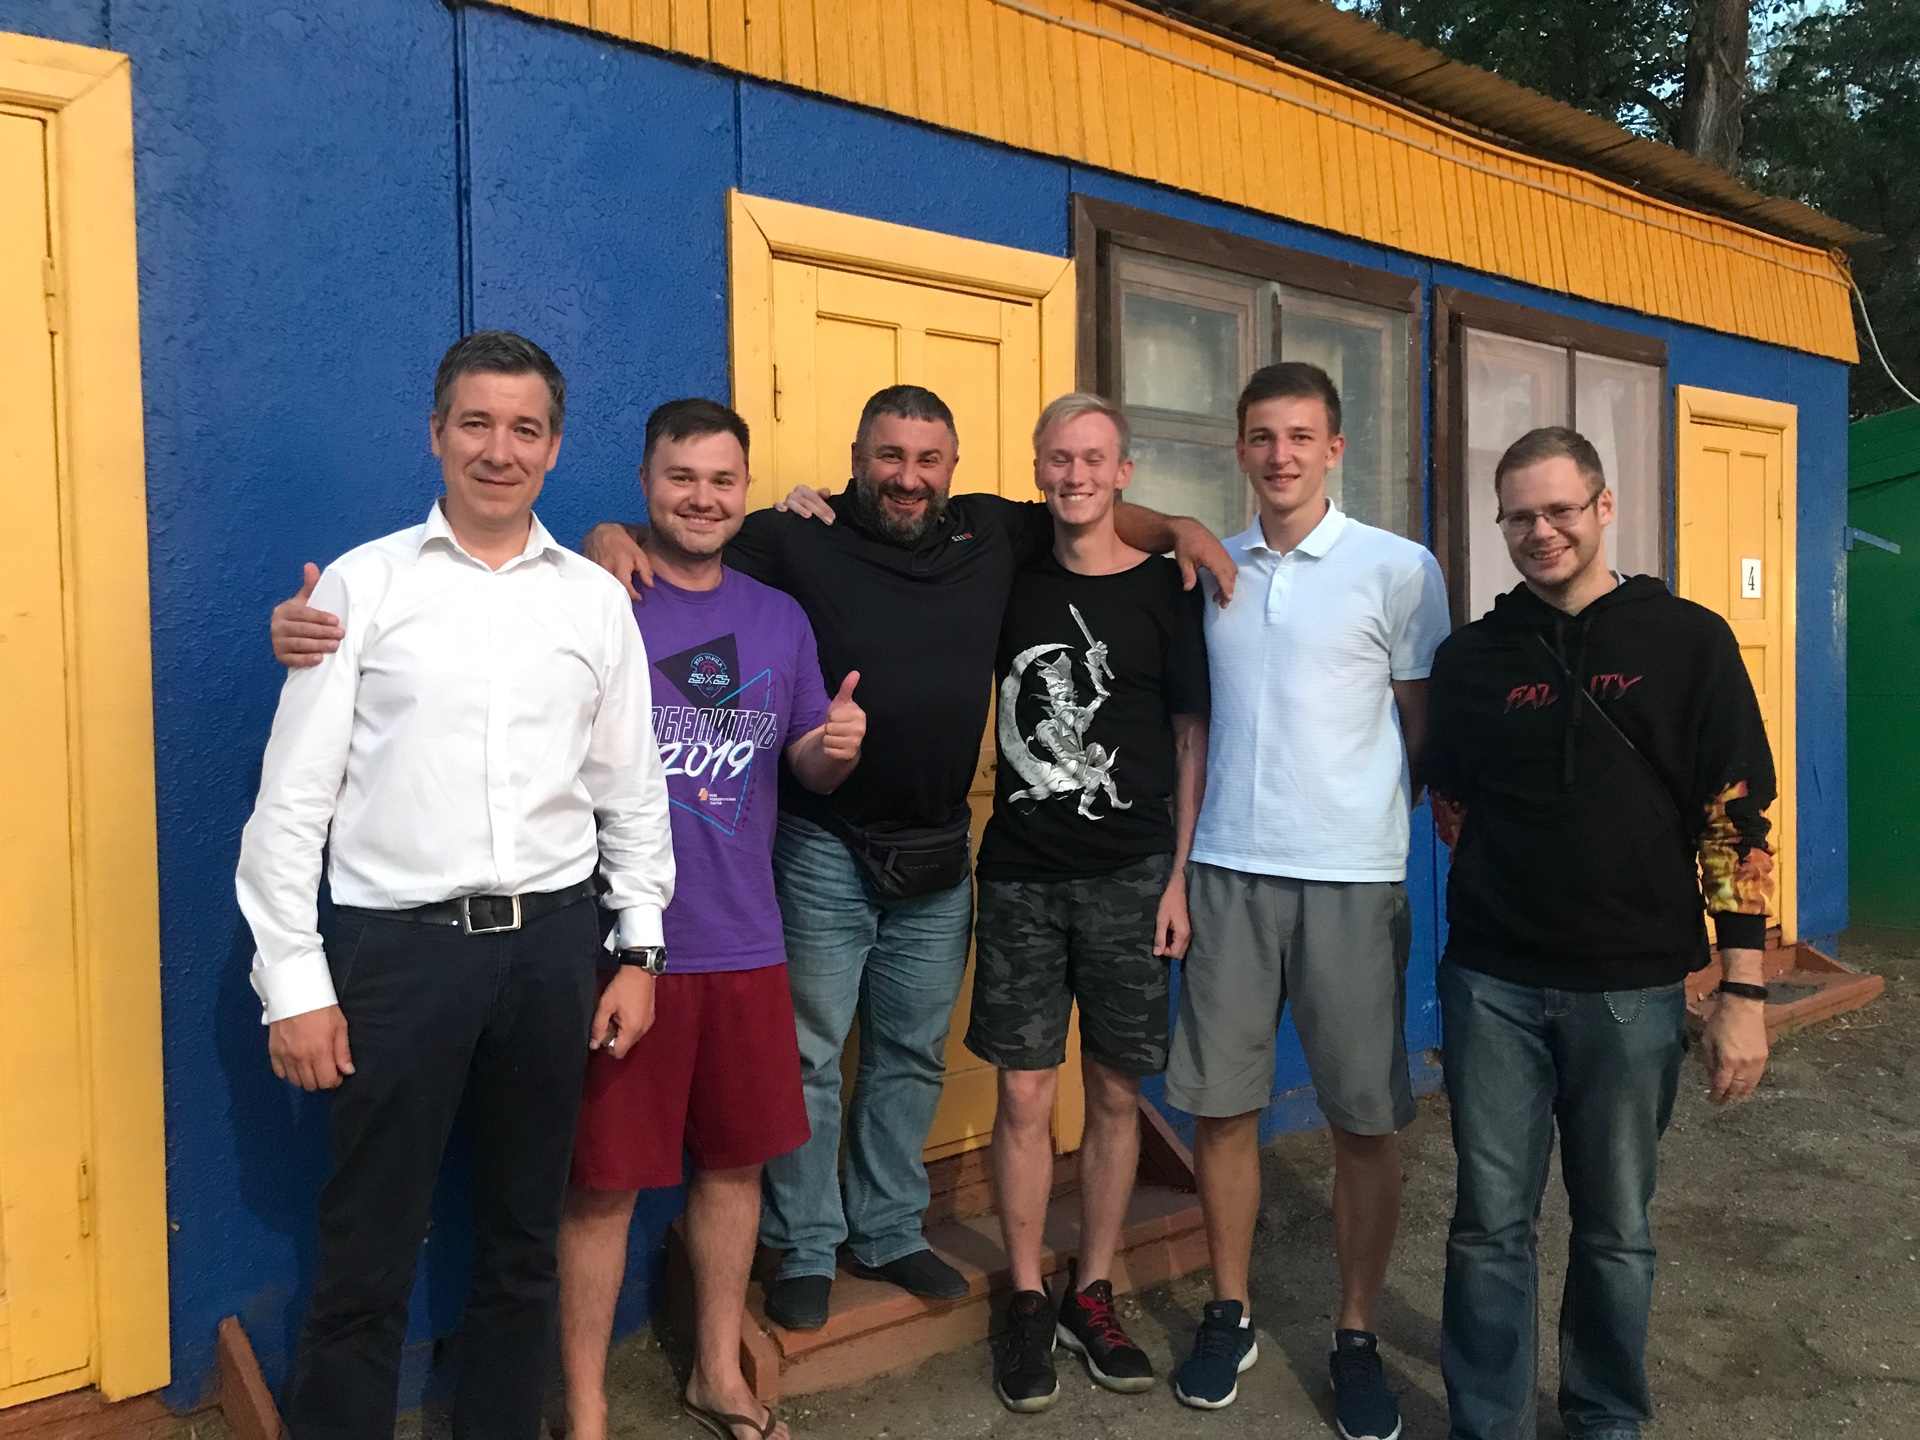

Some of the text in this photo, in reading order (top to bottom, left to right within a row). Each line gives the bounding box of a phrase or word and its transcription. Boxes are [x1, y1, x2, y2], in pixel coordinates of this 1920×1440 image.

[1747, 565, 1756, 591] 4
[1503, 673, 1644, 714] FATITY
[651, 705, 778, 749] ОБЕДИТЕЛЬ
[659, 739, 755, 785] 2019
